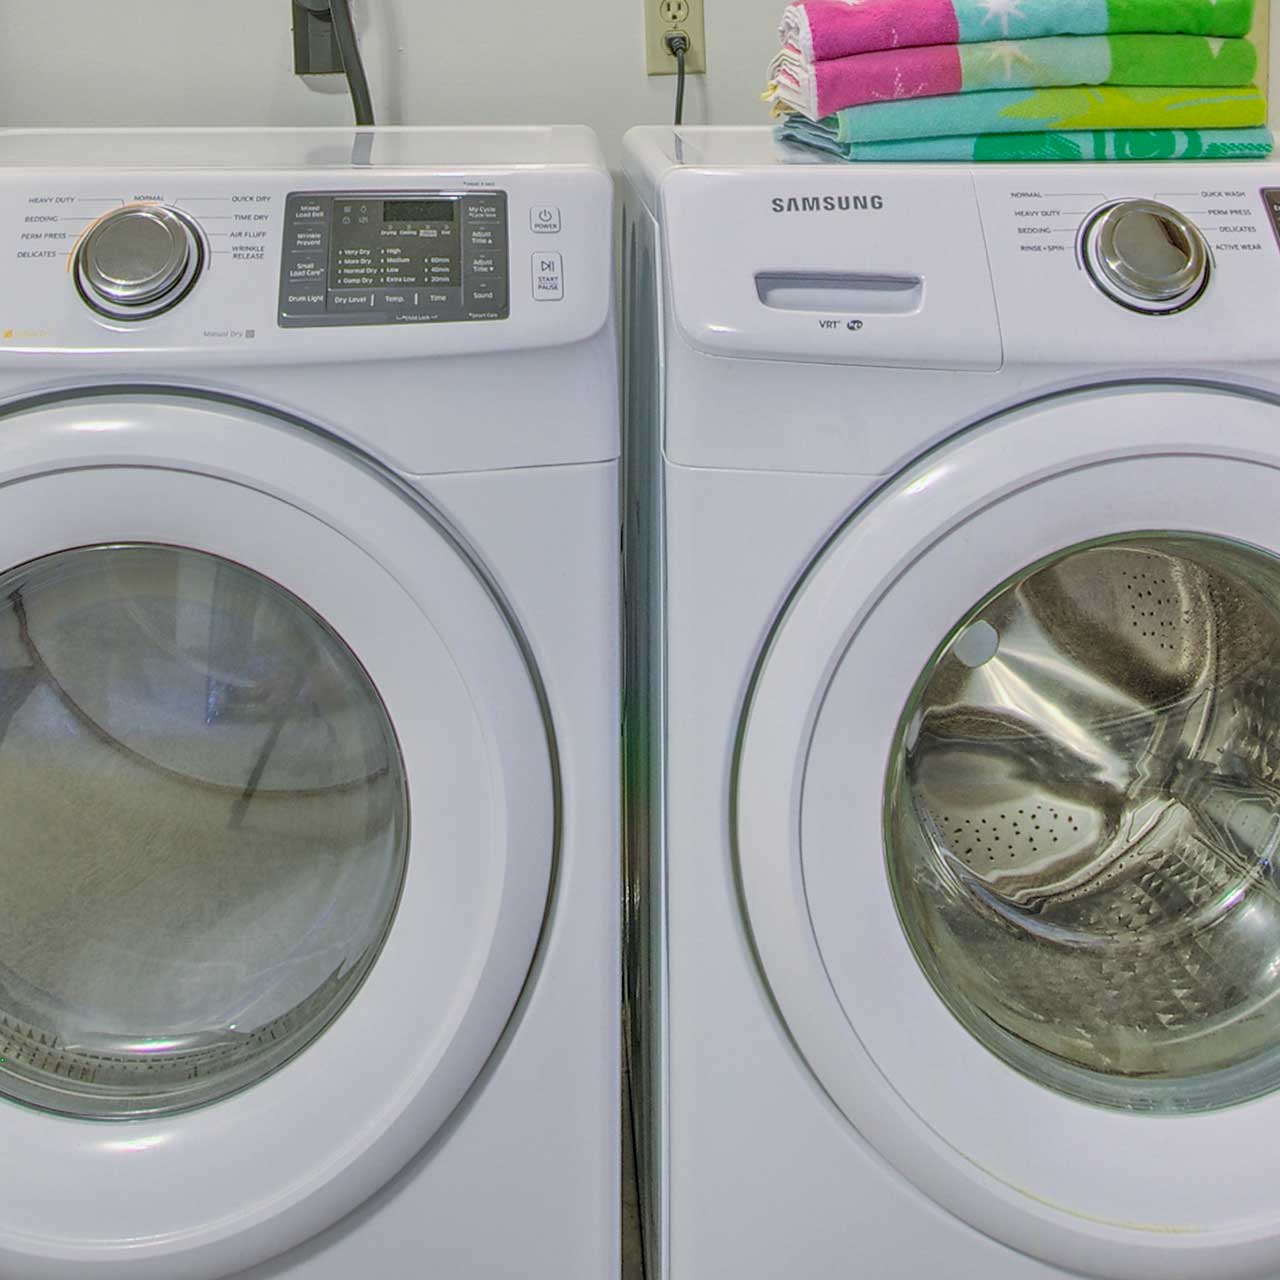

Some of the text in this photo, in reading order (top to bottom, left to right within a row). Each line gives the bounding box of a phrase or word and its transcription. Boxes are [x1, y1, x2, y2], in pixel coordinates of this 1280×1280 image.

[28, 196, 75, 204] HEAVY DUTY
[231, 195, 254, 203] QUICK
[772, 195, 883, 213] SAMSUNG
[24, 215, 58, 223] BEDDING
[21, 232, 42, 240] PERM
[472, 230, 491, 238] Adjust
[17, 250, 56, 258] DELICATES
[473, 259, 493, 267] Adjust
[290, 269, 306, 277] Load
[307, 295, 324, 303] Light
[473, 291, 493, 299] Sound
[334, 296, 348, 304] Dry
